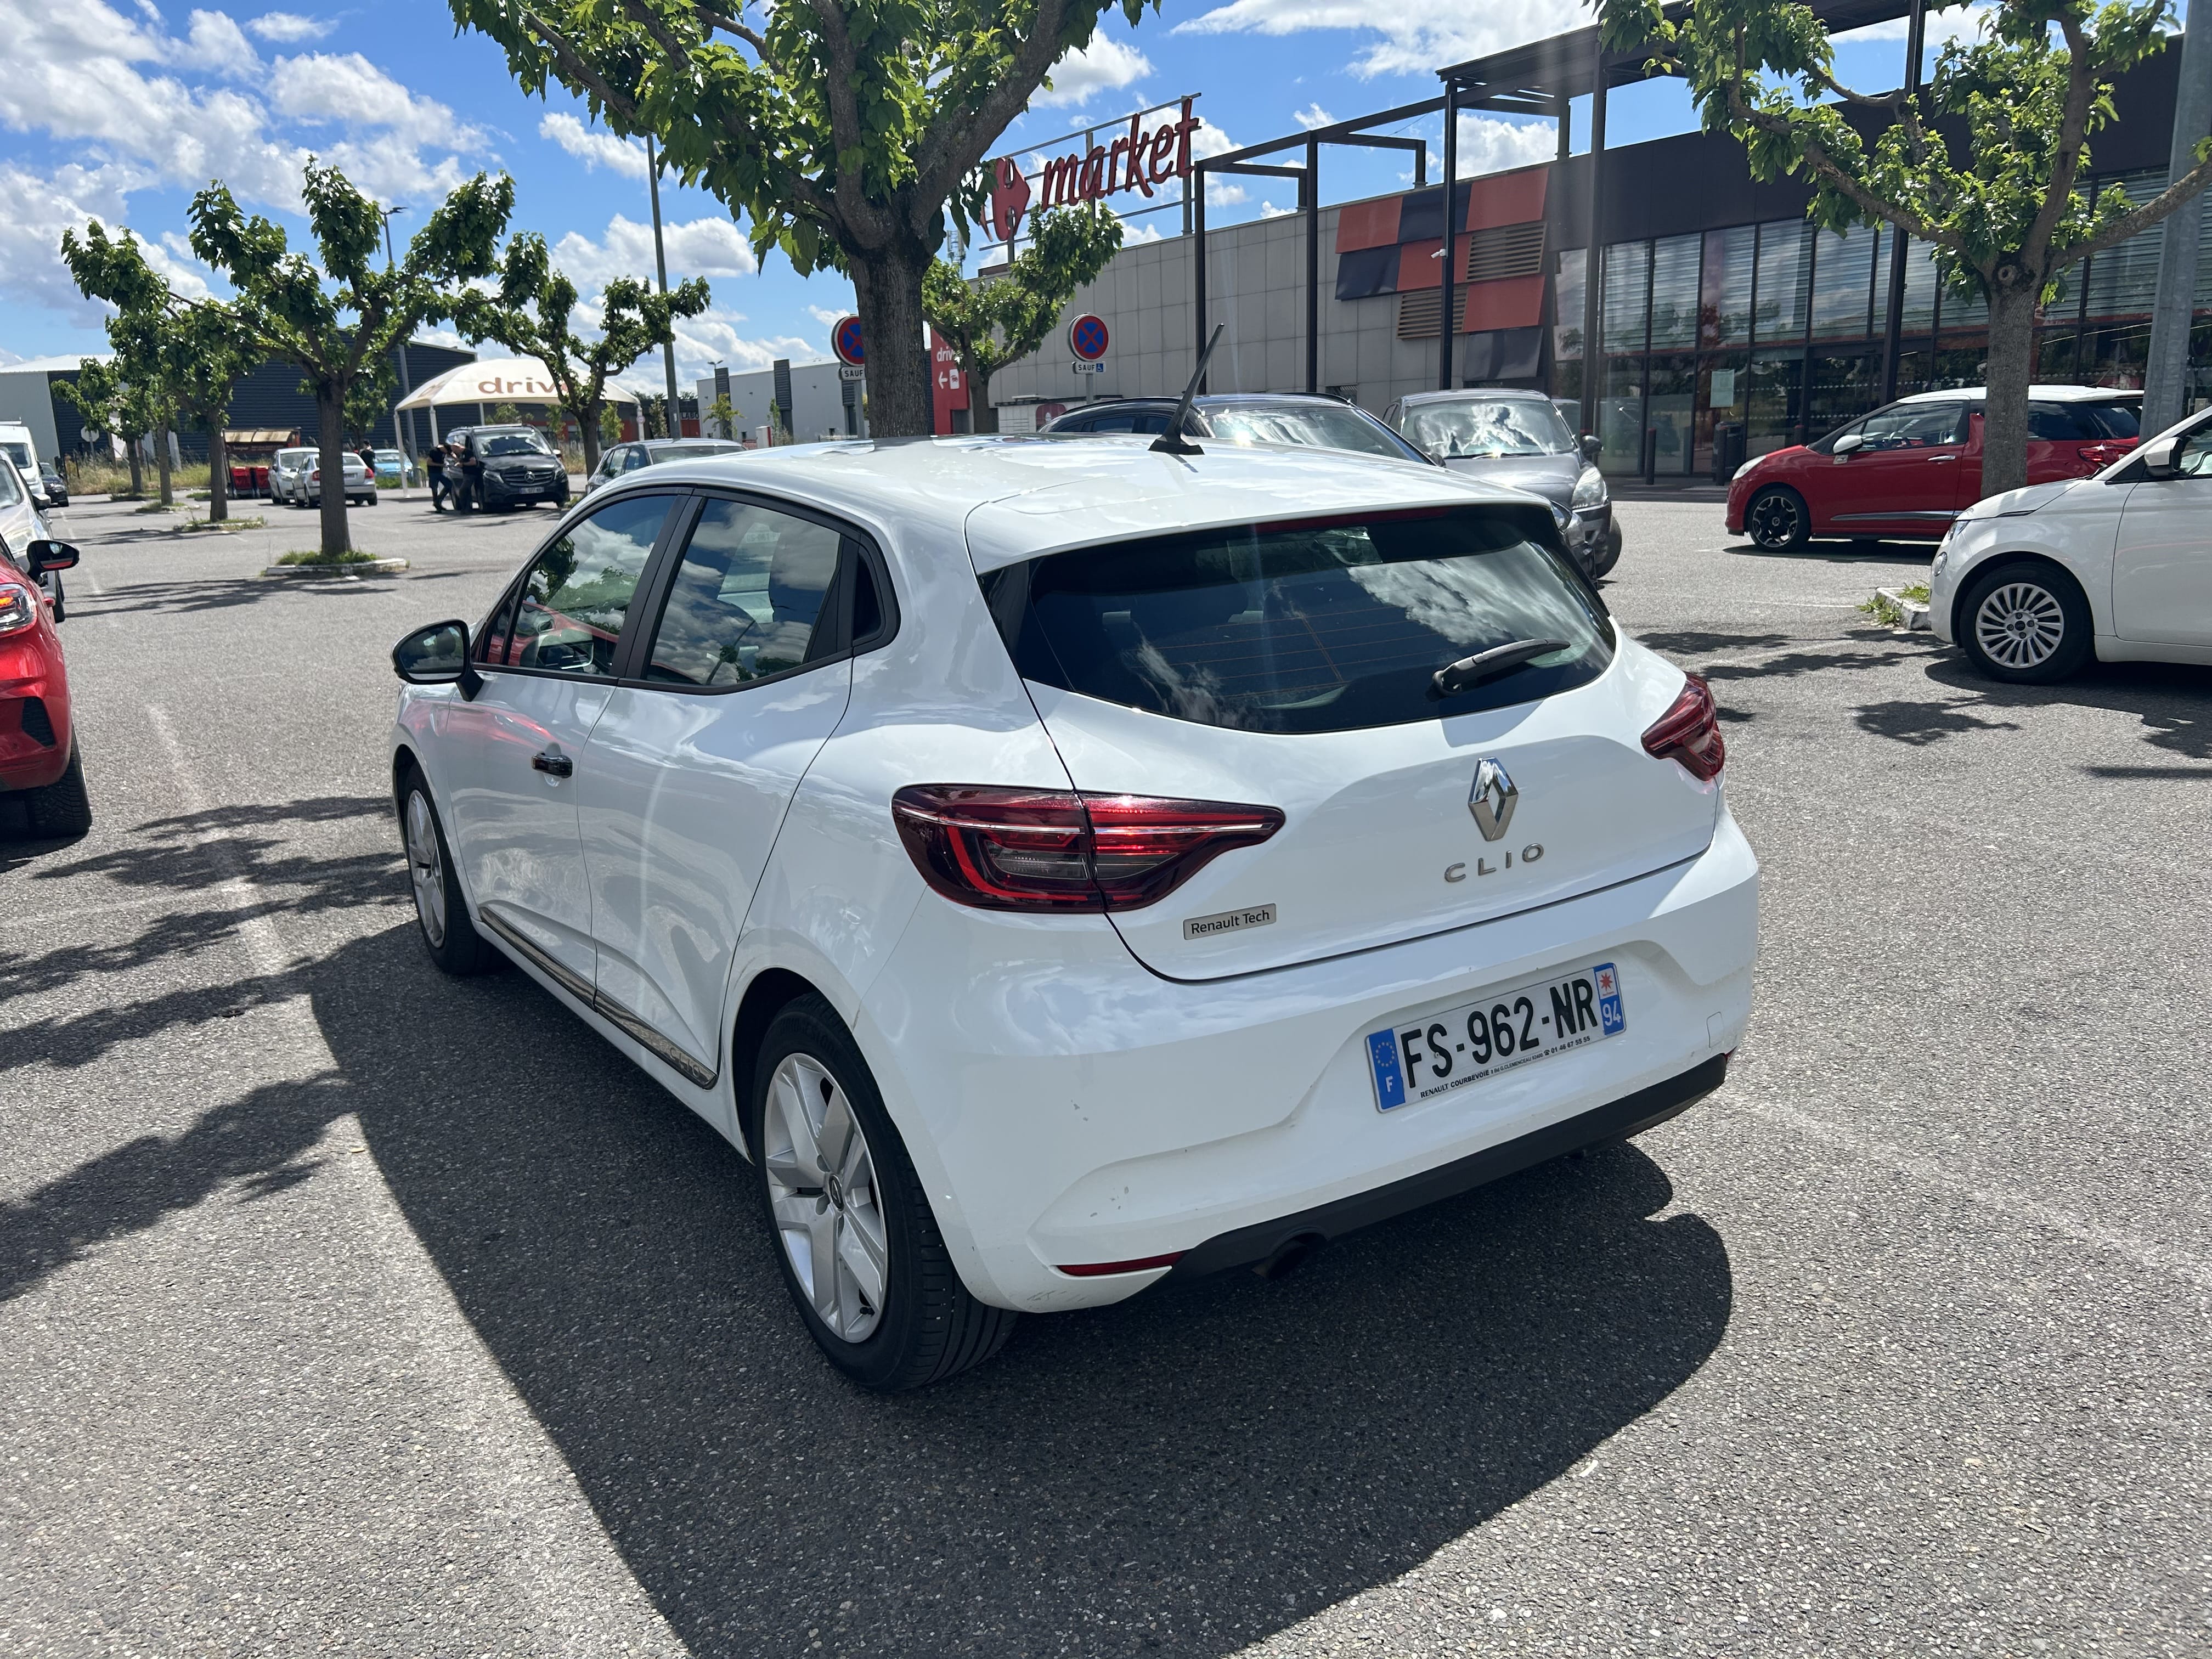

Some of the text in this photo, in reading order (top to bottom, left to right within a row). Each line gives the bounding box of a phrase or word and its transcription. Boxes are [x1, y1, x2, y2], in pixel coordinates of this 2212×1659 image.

[1042, 97, 1200, 213] market
[936, 346, 955, 362] driv
[844, 369, 864, 377] SAUF
[1444, 843, 1544, 883] CLIO
[1190, 910, 1270, 934] Renault Tech
[1602, 1000, 1622, 1026] 94
[1400, 978, 1598, 1088] FS-962-NR
[1385, 1075, 1394, 1093] F
[1420, 1083, 1449, 1098] RENAULT
[1451, 1069, 1489, 1088] COURBEVOIE
